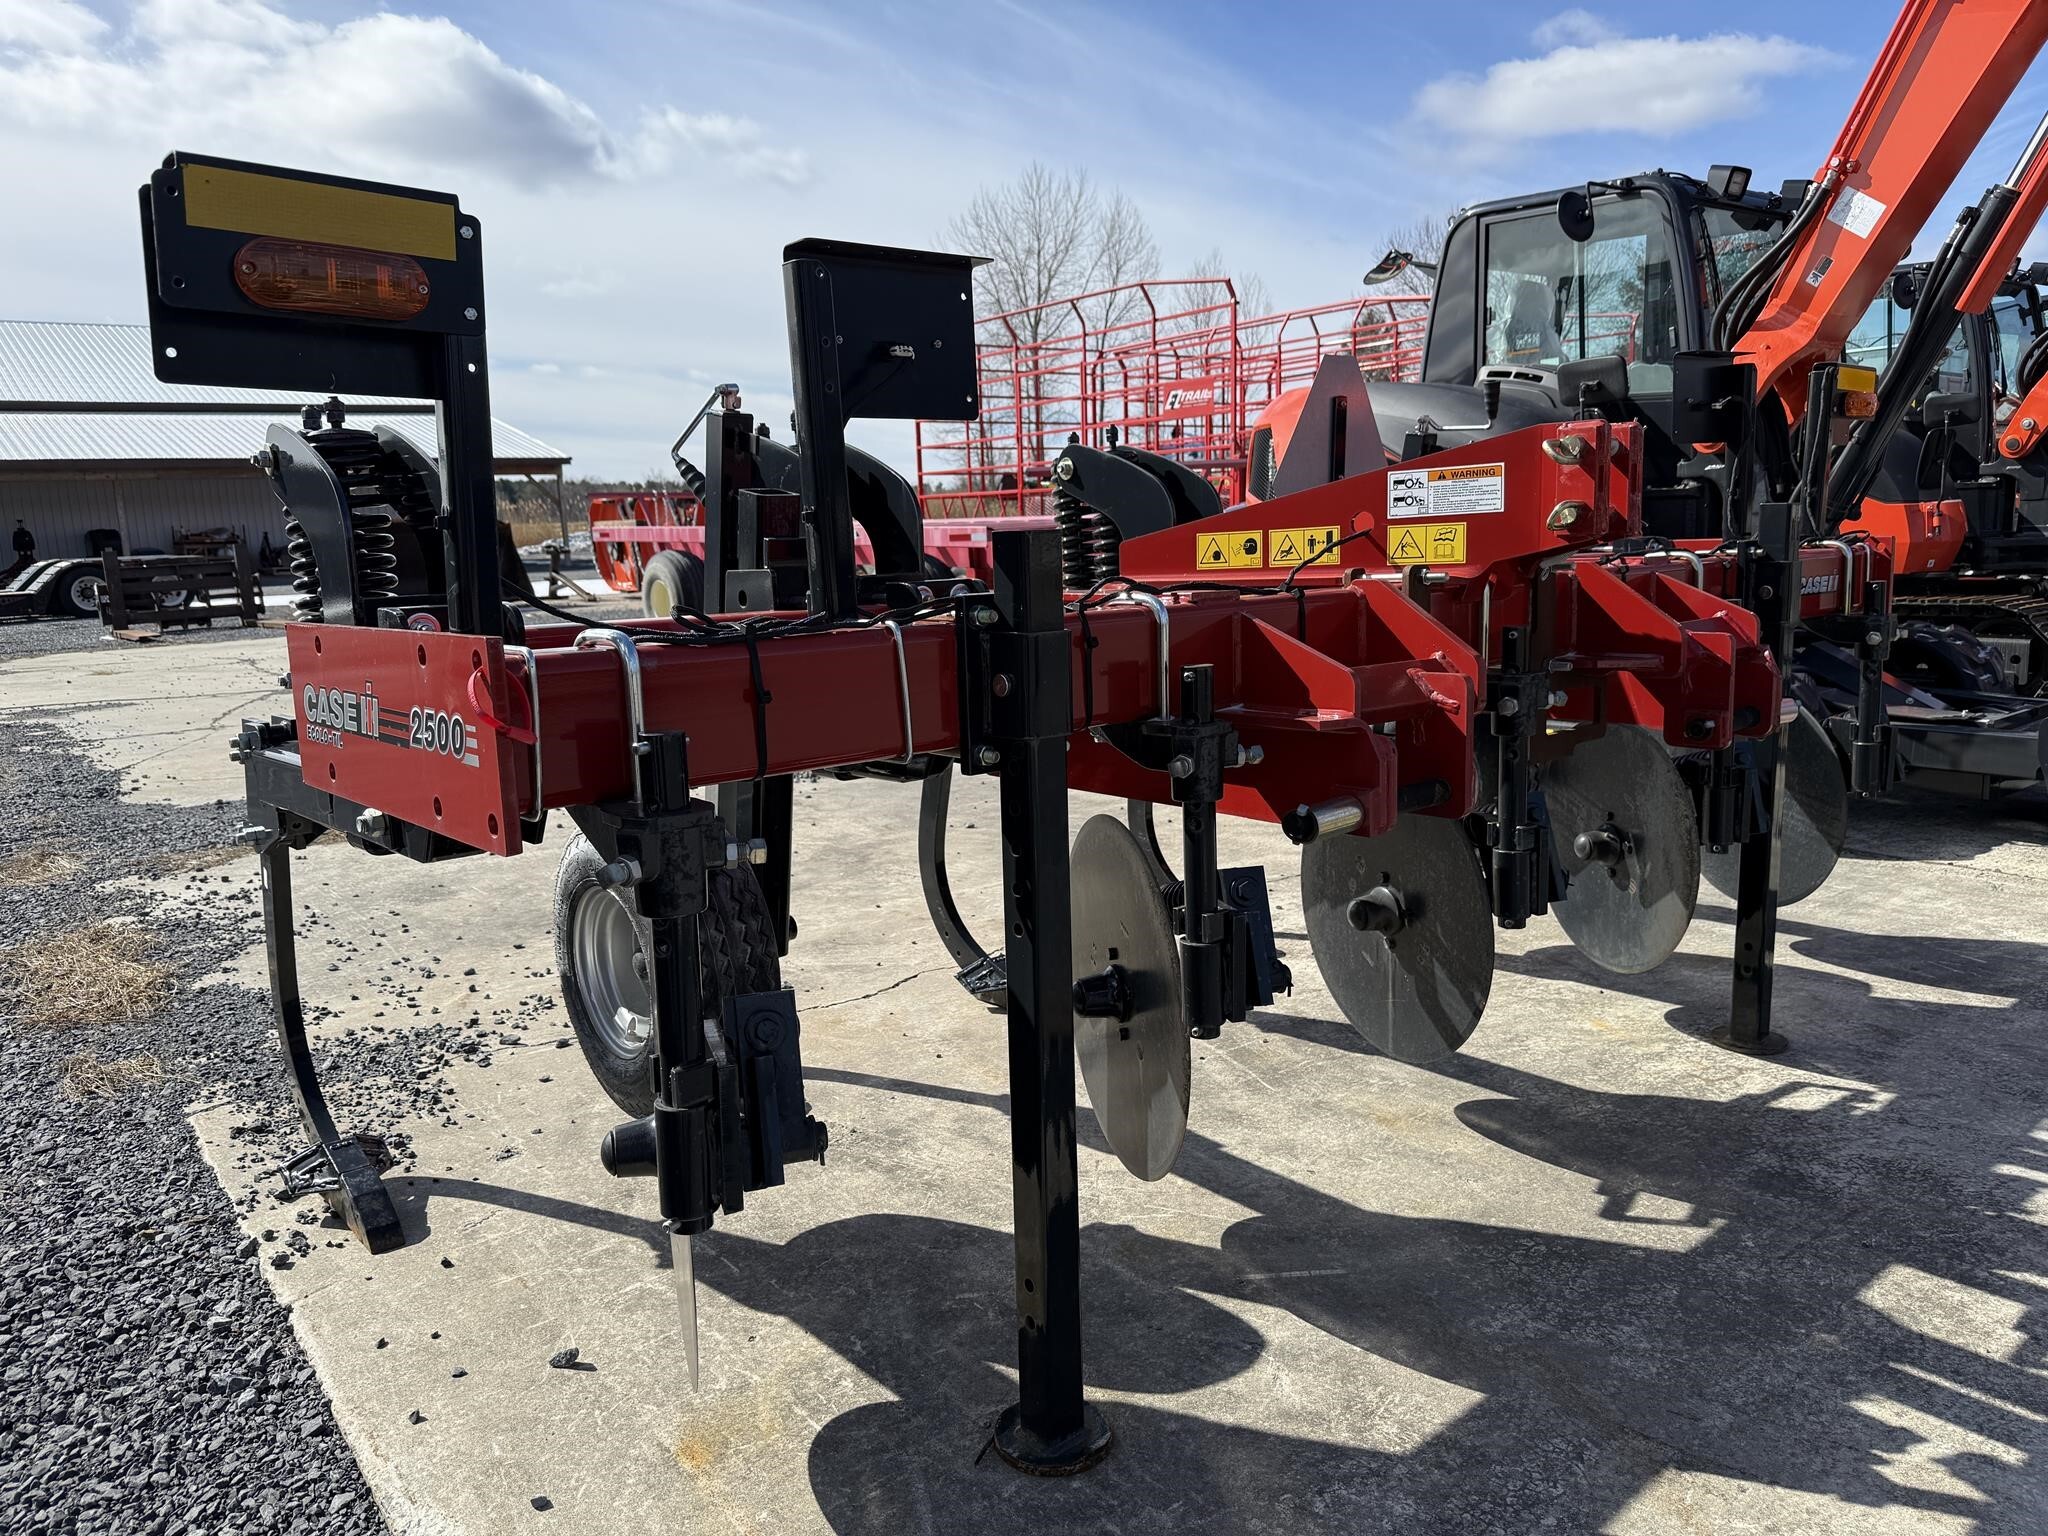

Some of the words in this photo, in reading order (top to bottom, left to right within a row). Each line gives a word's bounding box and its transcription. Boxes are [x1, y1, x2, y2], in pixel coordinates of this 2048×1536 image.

[1451, 468, 1496, 479] WARNING
[1800, 576, 1828, 595] CASE
[303, 683, 357, 732] CASE
[409, 704, 465, 759] 2500
